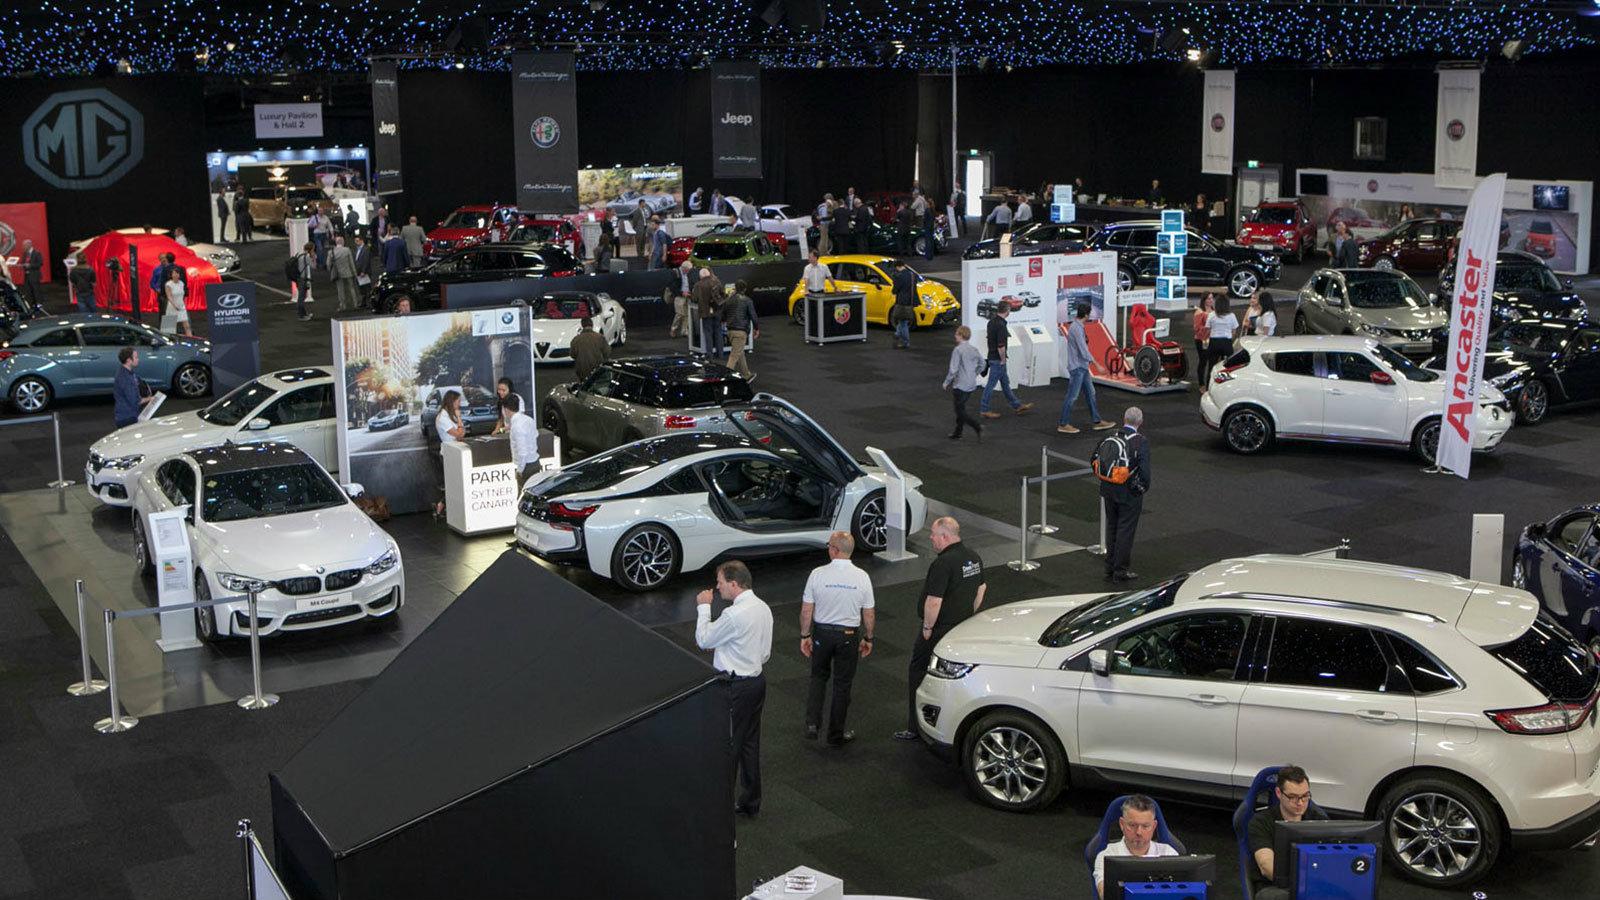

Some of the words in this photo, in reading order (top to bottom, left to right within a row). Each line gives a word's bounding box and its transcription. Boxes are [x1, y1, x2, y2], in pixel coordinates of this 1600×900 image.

[259, 113, 286, 121] Luxury
[287, 112, 318, 120] Pavilion
[721, 112, 753, 126] Jeep
[379, 121, 396, 136] Jeep
[38, 102, 126, 177] MG
[214, 308, 250, 317] HYUNDAI
[1473, 310, 1484, 345] Quality
[1447, 249, 1482, 443] Ancaster
[1468, 347, 1480, 396] Delivering
[471, 468, 511, 485] PARK
[471, 486, 513, 500] SYTNER
[471, 499, 514, 512] CANARY
[1356, 860, 1365, 871] 2
